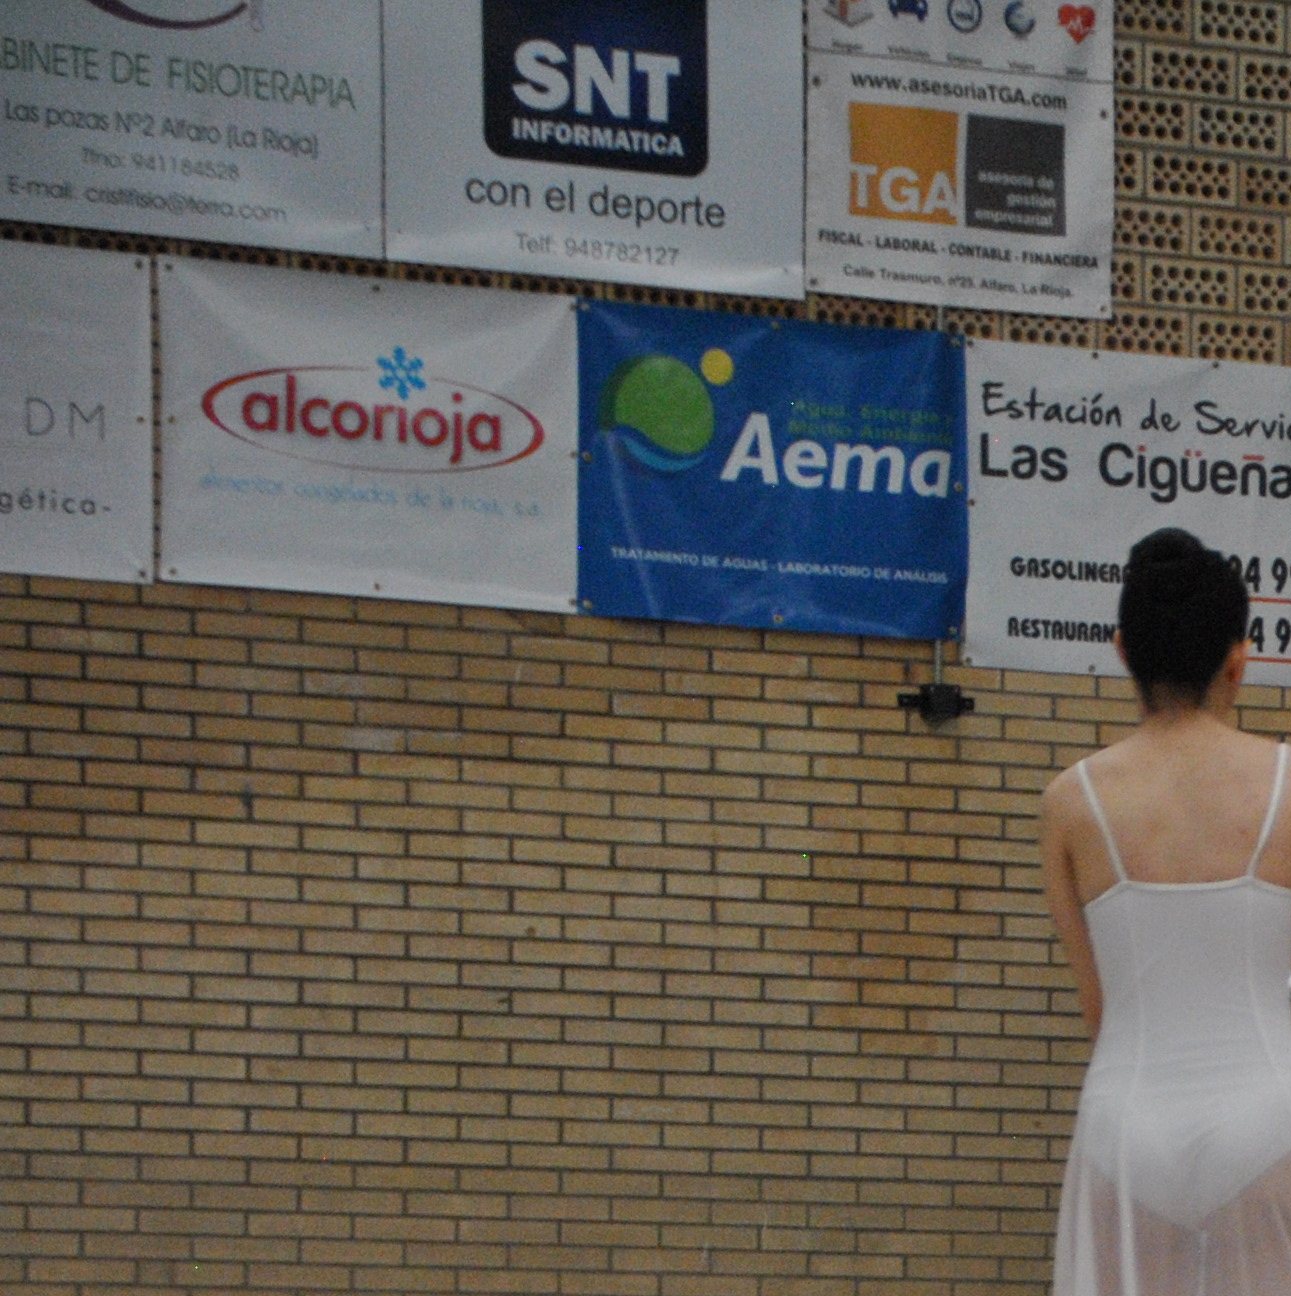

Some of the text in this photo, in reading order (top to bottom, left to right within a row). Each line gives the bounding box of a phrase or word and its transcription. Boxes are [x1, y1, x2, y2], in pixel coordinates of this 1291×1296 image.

[111, 50, 151, 87] DE
[167, 57, 356, 110] FISIOTERAPIA
[511, 38, 682, 124] SNT
[850, 71, 1068, 111] www.asesoriaTGA.com
[4, 98, 40, 123] Las
[511, 116, 686, 158] INFORMATICA
[464, 176, 726, 229] con el deporte
[850, 162, 956, 217] TGA
[564, 237, 680, 267] 948782127
[817, 228, 1099, 269] FISCAL LABORAL CONTABLE FINANCIERA
[843, 264, 875, 280] Calle
[1021, 283, 1039, 295] La
[241, 373, 502, 464] alcorioja
[981, 381, 1123, 428] Estación
[1140, 397, 1181, 433] de
[720, 411, 952, 499] Aema
[979, 432, 1069, 482] Las
[610, 546, 699, 567] TRATAMIENTO
[702, 553, 718, 568] DE
[722, 554, 768, 572] AGUAS
[777, 560, 871, 579] LABORATORIO
[873, 566, 891, 580] DE
